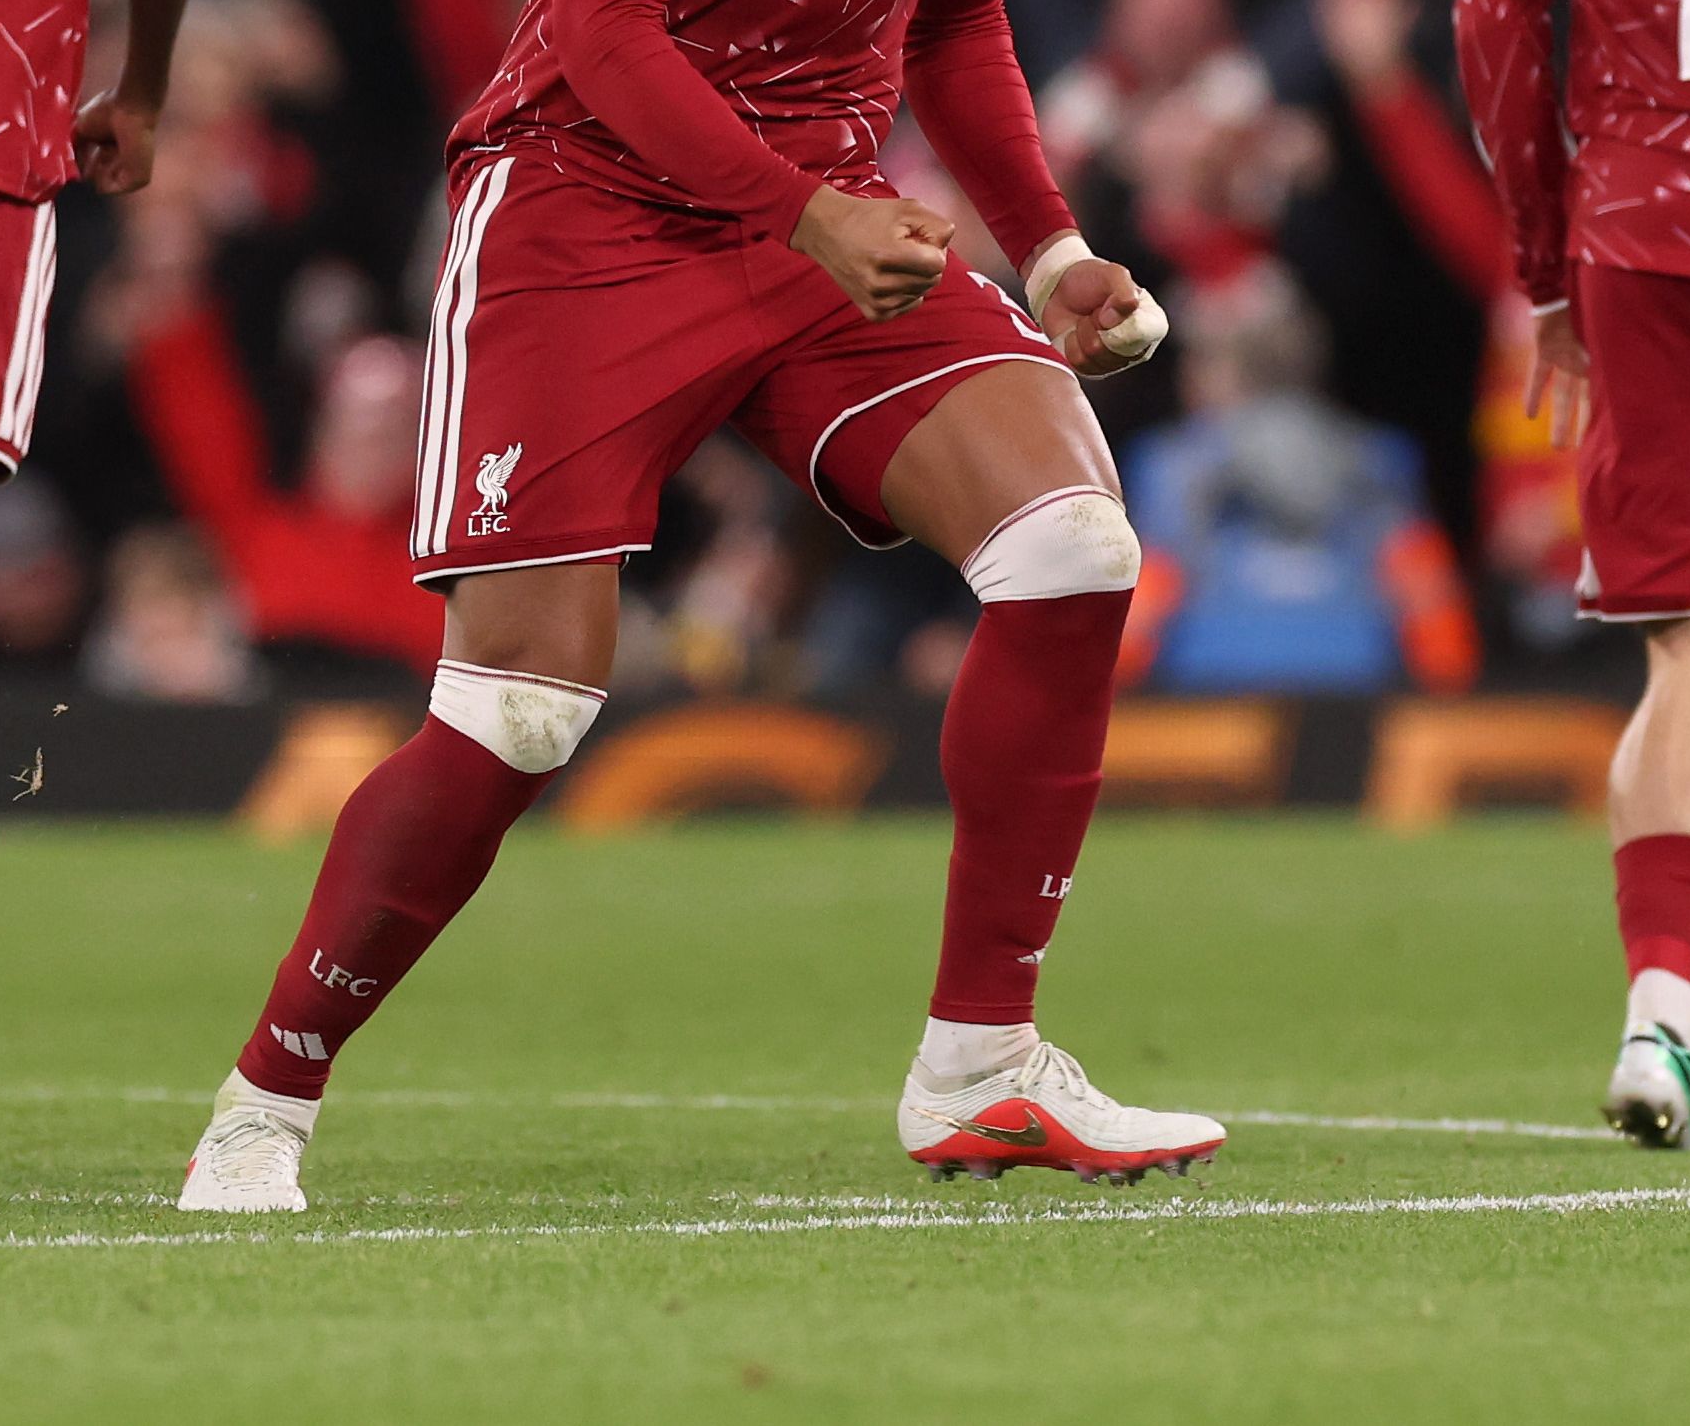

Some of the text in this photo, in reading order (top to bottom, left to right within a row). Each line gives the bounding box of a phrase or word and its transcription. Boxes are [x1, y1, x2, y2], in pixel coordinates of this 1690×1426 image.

[467, 515, 511, 537] L.F.C.
[1038, 873, 1073, 900] LF
[308, 947, 378, 997] LFC
